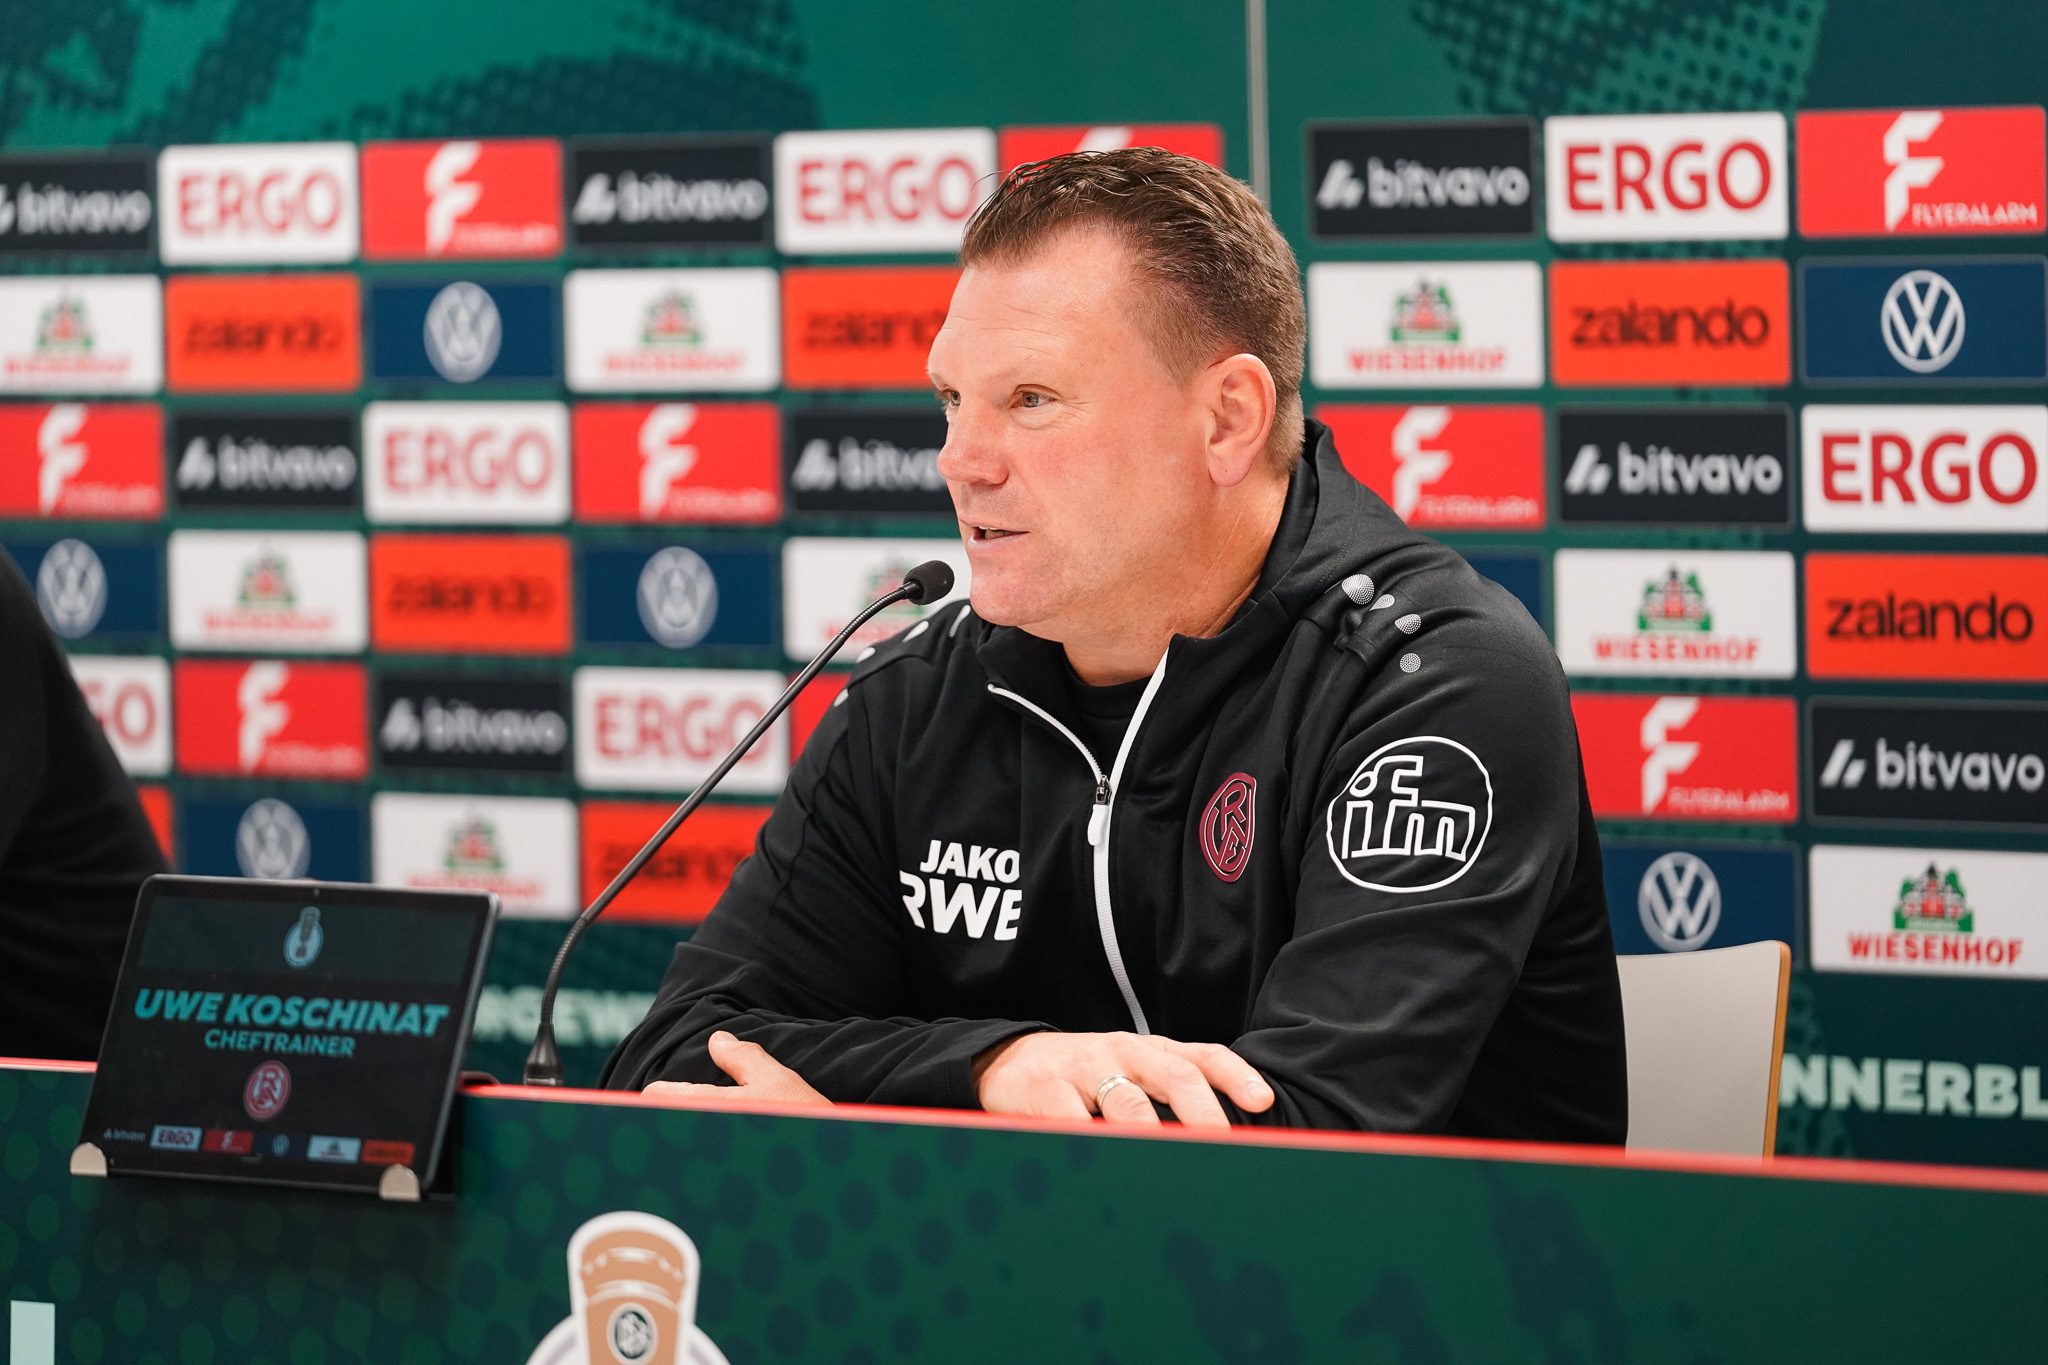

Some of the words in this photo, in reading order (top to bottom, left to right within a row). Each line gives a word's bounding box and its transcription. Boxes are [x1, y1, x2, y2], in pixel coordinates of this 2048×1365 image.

[178, 170, 343, 234] ERGO
[798, 157, 977, 224] ERGO
[1366, 156, 1531, 208] bitvavo
[1566, 142, 1772, 212] ERGO
[1911, 203, 2037, 227] FLYERALARM
[1570, 299, 1770, 348] zalando
[384, 430, 554, 492] ERGO
[1617, 442, 1783, 495] bitvavo
[1820, 432, 2038, 504] ERGO
[1826, 592, 2034, 643] zalando
[1593, 636, 1759, 662] WIESENHOF
[595, 695, 772, 762] ERGO
[1876, 738, 2045, 792] bitvavo
[920, 839, 1020, 884] JAKO
[899, 870, 1023, 941] RWE
[1848, 933, 2024, 967] WIESENHOF
[134, 988, 224, 1023] UWE
[225, 994, 449, 1037] KOSCHINAT
[204, 1028, 356, 1058] CHEFTRAINER
